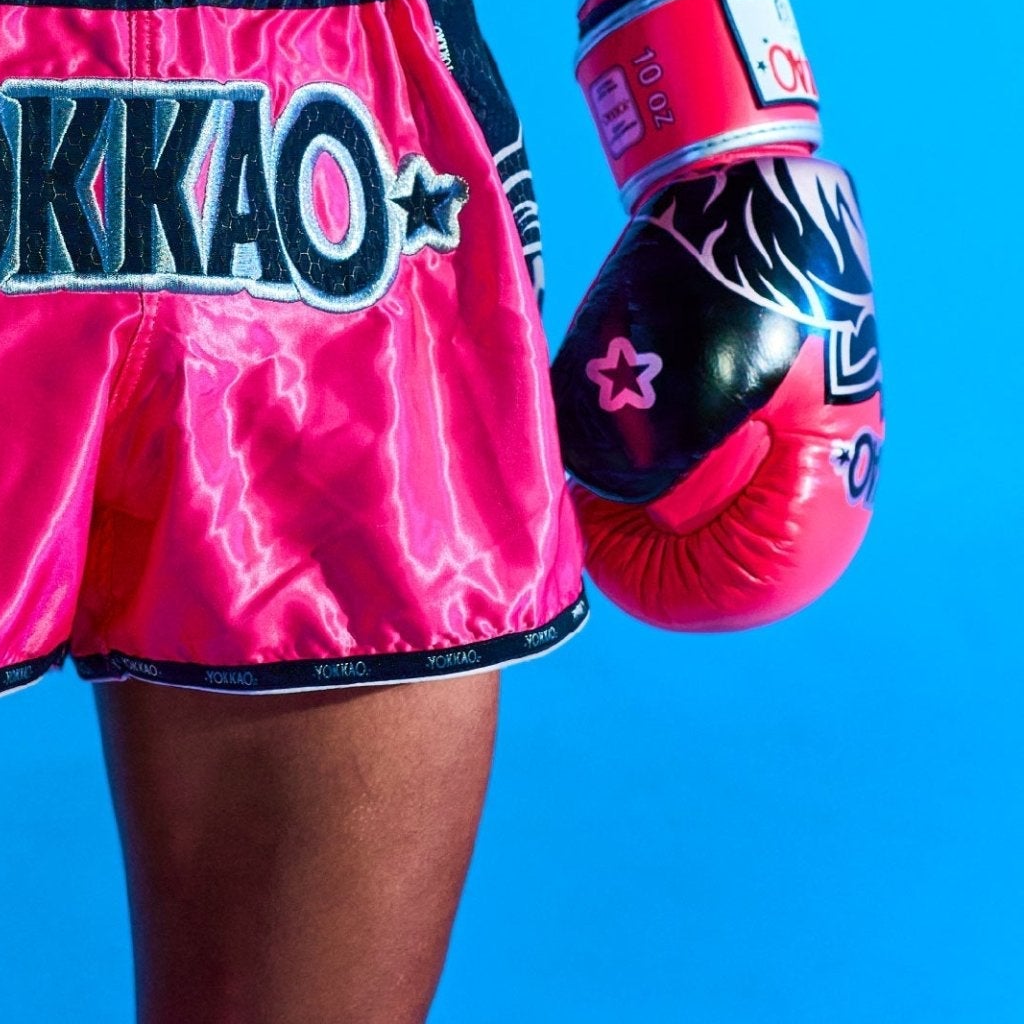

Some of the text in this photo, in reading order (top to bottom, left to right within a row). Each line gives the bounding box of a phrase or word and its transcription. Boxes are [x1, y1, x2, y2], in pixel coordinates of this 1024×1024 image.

[633, 47, 674, 128] 10 OZ
[428, 649, 478, 670] YOKKAO
[207, 670, 253, 686] YOKKAO
[315, 661, 366, 679] YOKKAO
